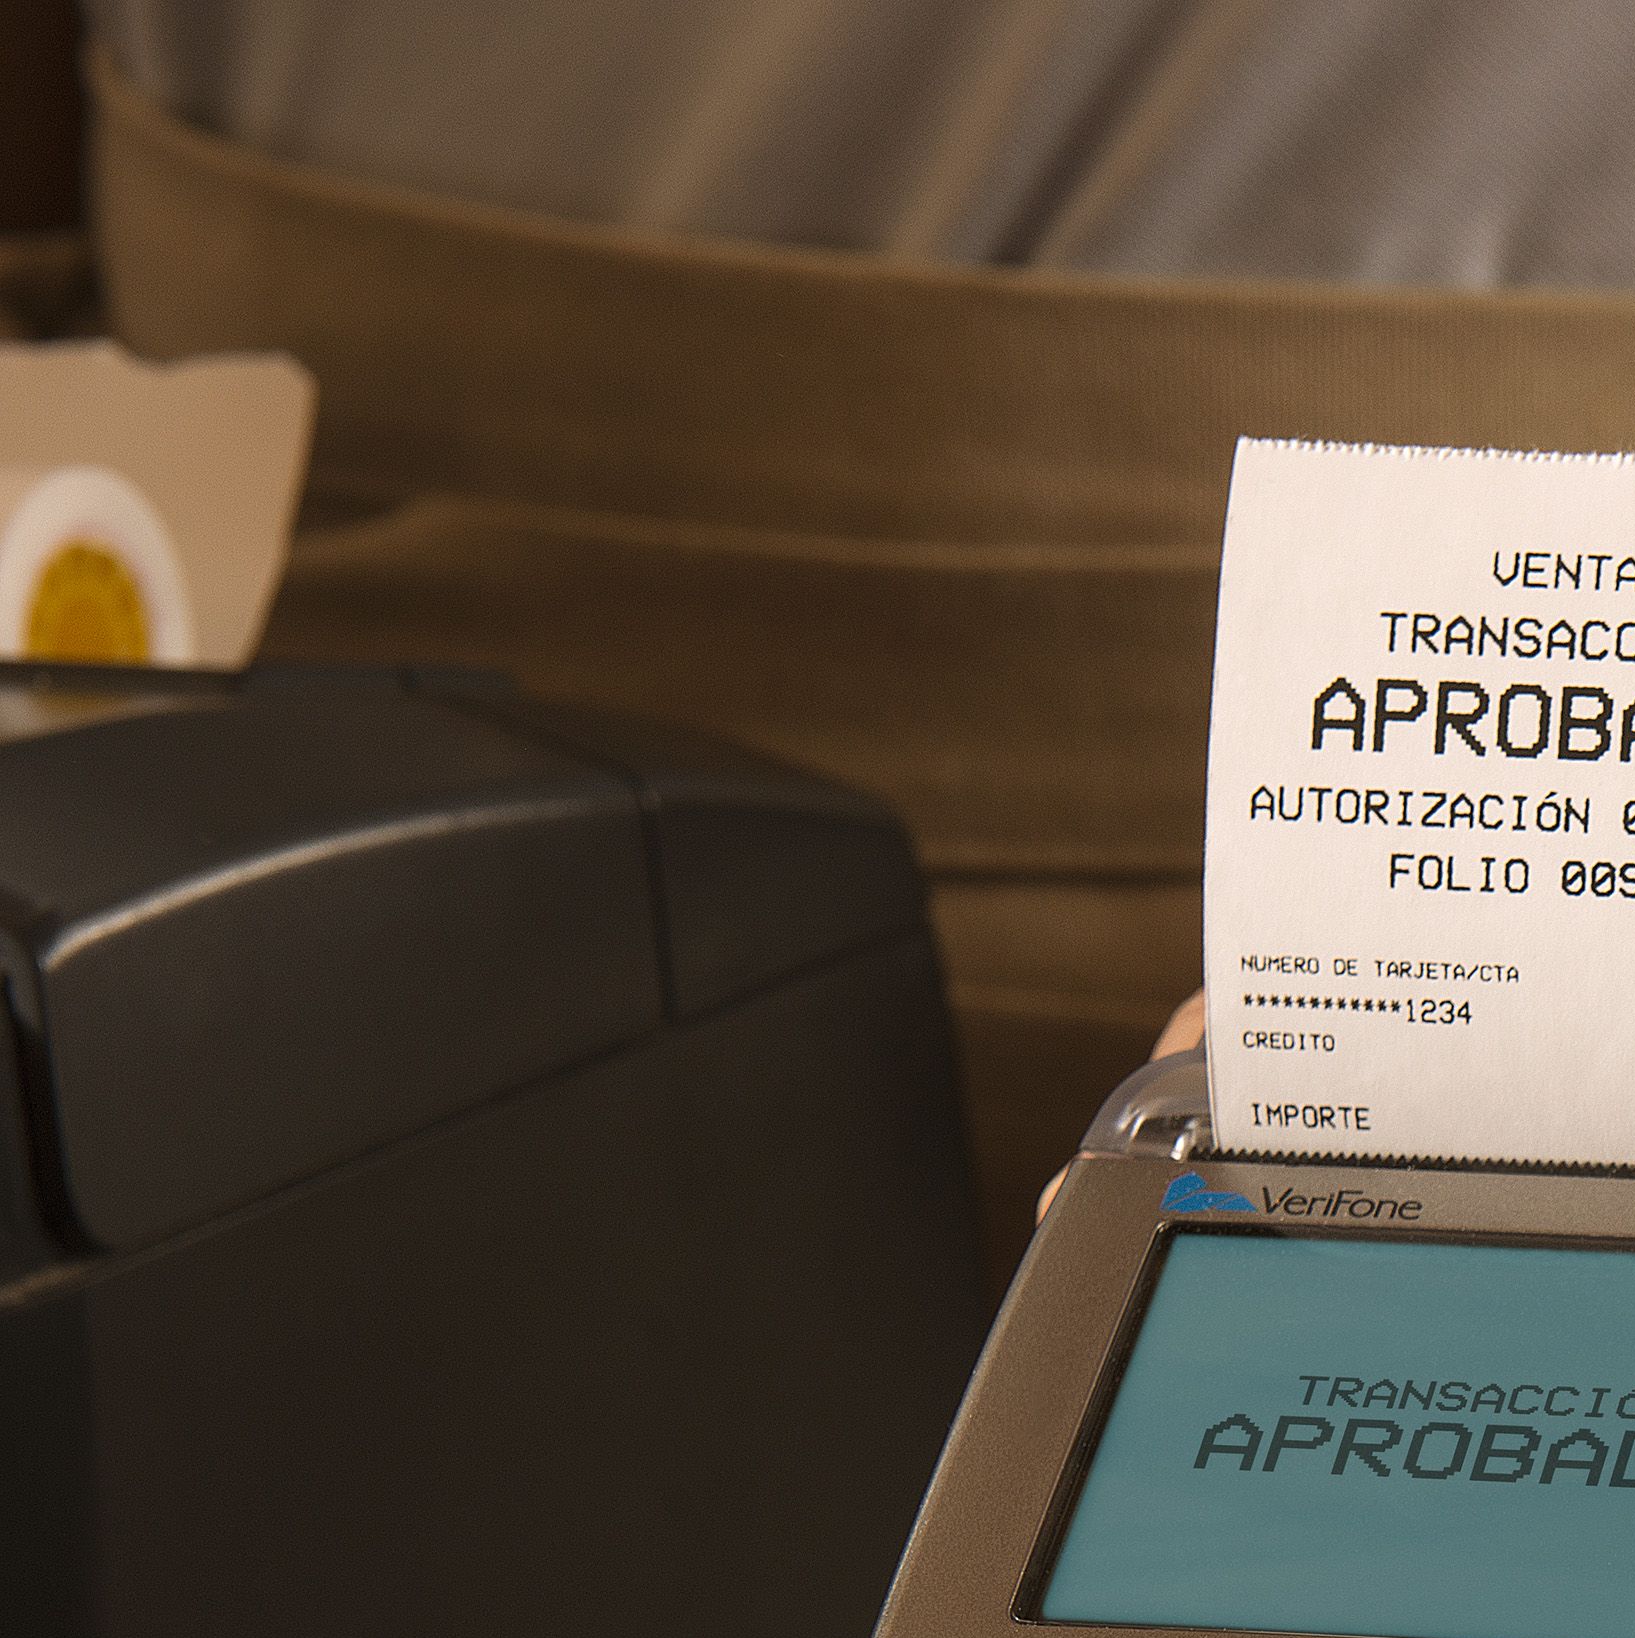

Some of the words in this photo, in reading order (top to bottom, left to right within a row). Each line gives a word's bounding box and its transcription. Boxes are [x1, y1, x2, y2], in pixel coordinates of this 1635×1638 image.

[1250, 786, 1590, 834] AUTORIZACIÓN
[1390, 855, 1529, 895] FOLIO
[1241, 955, 1320, 975] NUMERO
[1334, 958, 1358, 976] DE
[1375, 960, 1519, 983] TARJETA/CTA
[1243, 1031, 1335, 1052] CREDITO
[1252, 1103, 1371, 1130] IMPORTE
[1262, 1185, 1423, 1221] VeriFone
